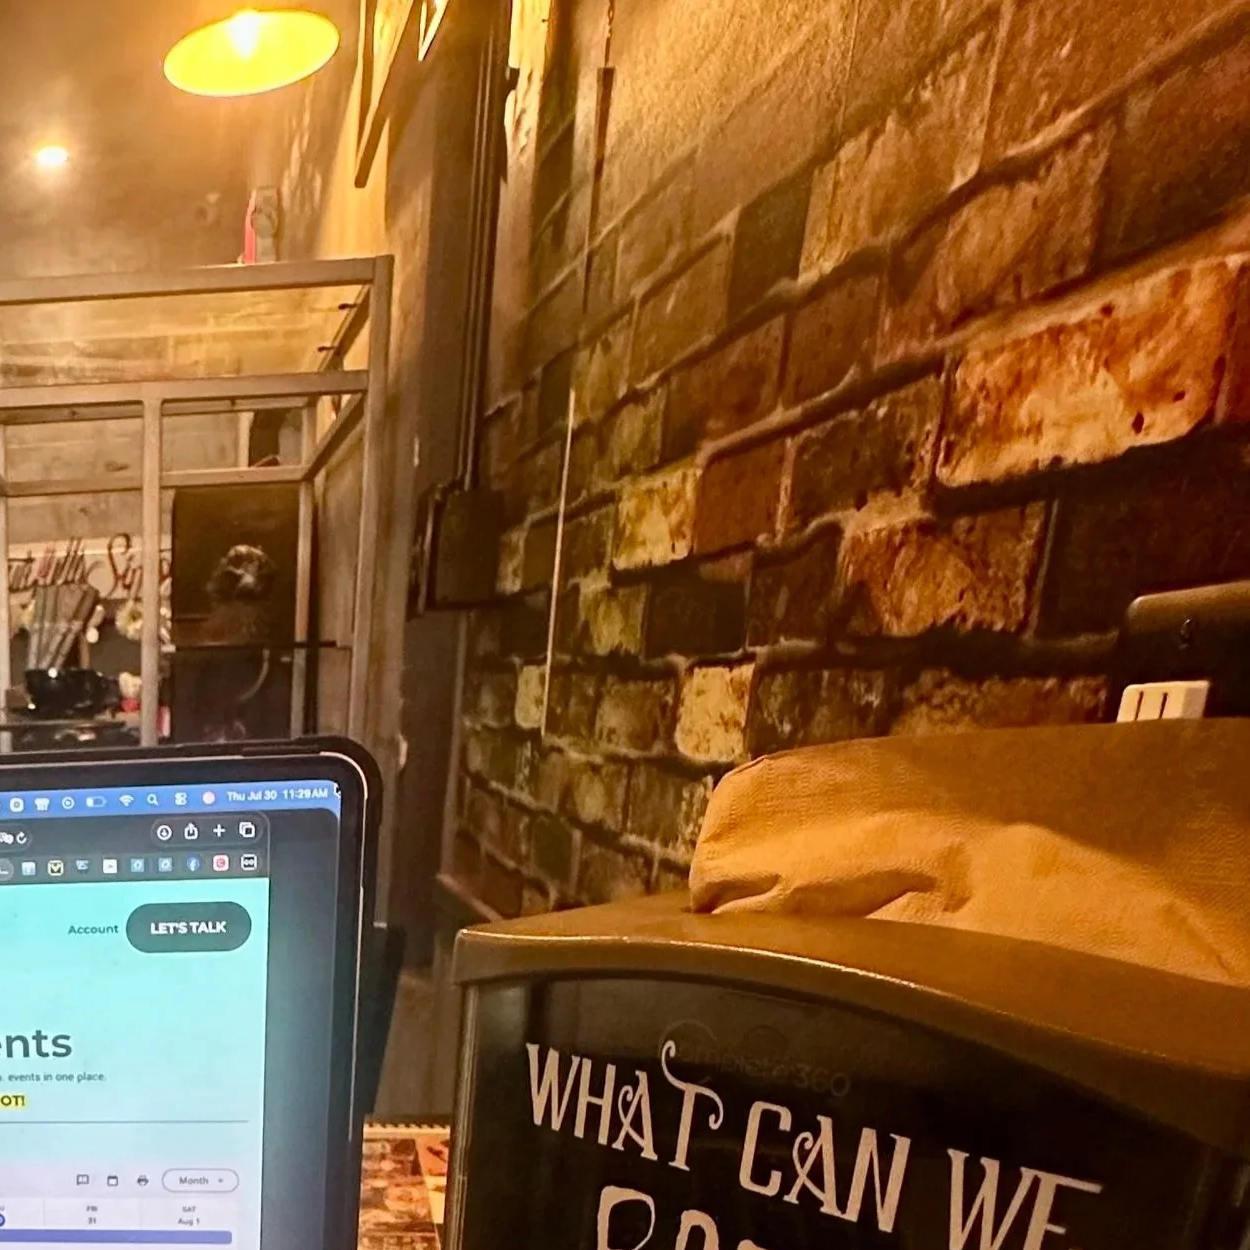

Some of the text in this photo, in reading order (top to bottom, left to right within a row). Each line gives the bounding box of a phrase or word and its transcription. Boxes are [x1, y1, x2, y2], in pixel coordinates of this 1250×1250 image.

[227, 791, 245, 801] Thu
[248, 791, 263, 801] Jul
[265, 790, 277, 800] 30
[68, 924, 119, 935] Account
[150, 921, 227, 935] LET'S TALK
[8, 1072, 41, 1082] events
[43, 1072, 53, 1081] in
[55, 1073, 74, 1082] one
[77, 1072, 107, 1084] place.
[525, 1040, 724, 1172] WHAT
[738, 1100, 912, 1233] CAN
[179, 1176, 209, 1186] Month
[178, 1218, 194, 1227] Aug
